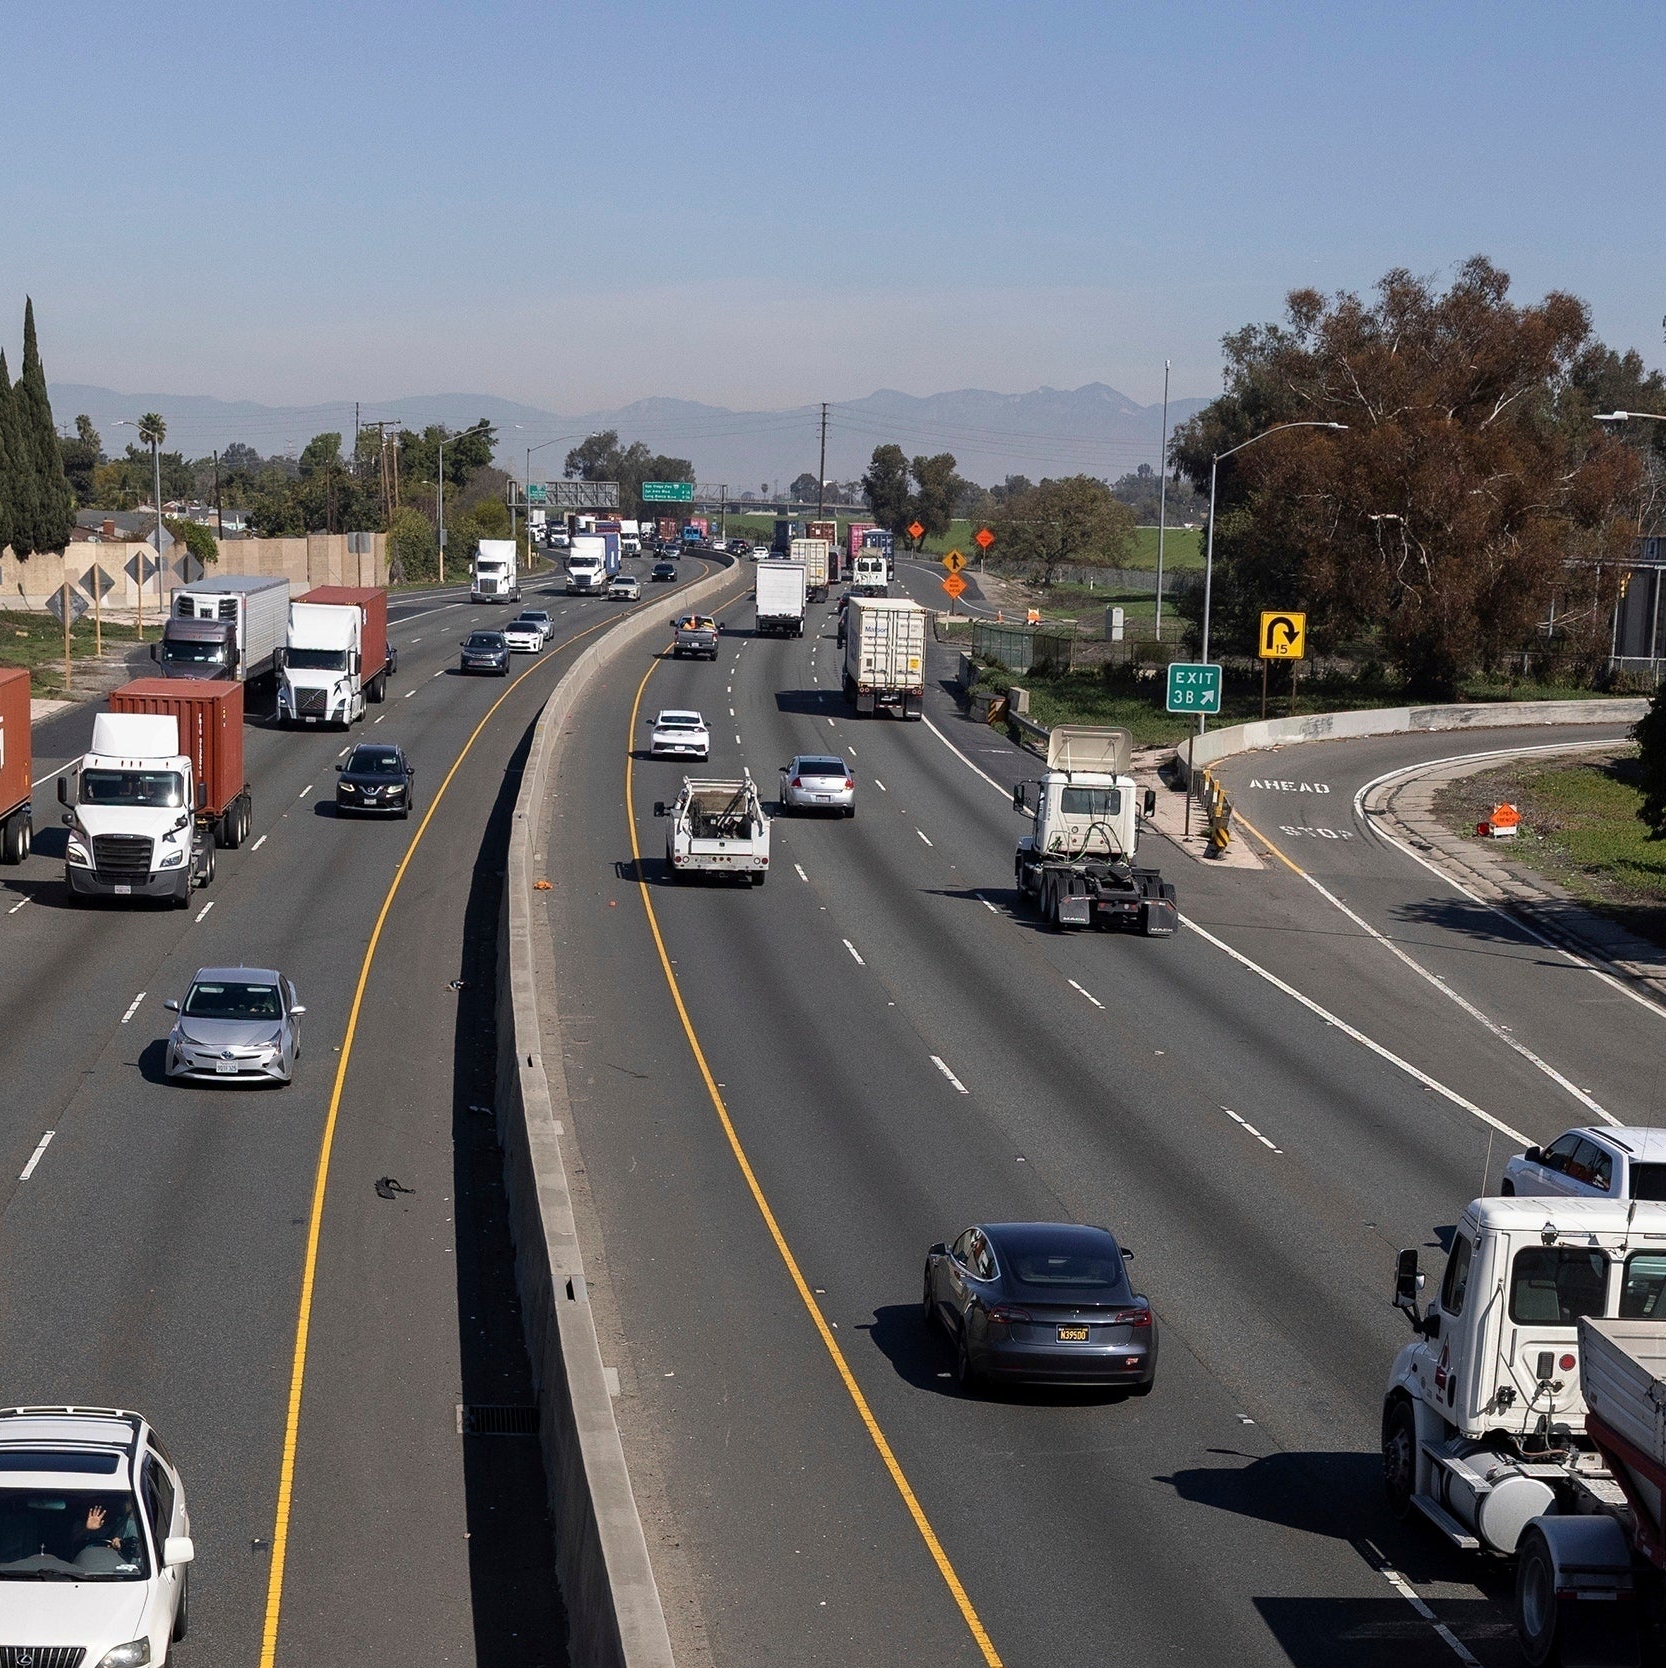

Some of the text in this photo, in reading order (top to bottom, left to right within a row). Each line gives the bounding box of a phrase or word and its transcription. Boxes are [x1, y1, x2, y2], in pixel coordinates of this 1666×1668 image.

[1275, 644, 1288, 655] 15
[1175, 671, 1214, 685] EXIT
[1173, 690, 1194, 705] 3B
[1249, 779, 1331, 794] AHEAD
[1278, 825, 1354, 840] STOP
